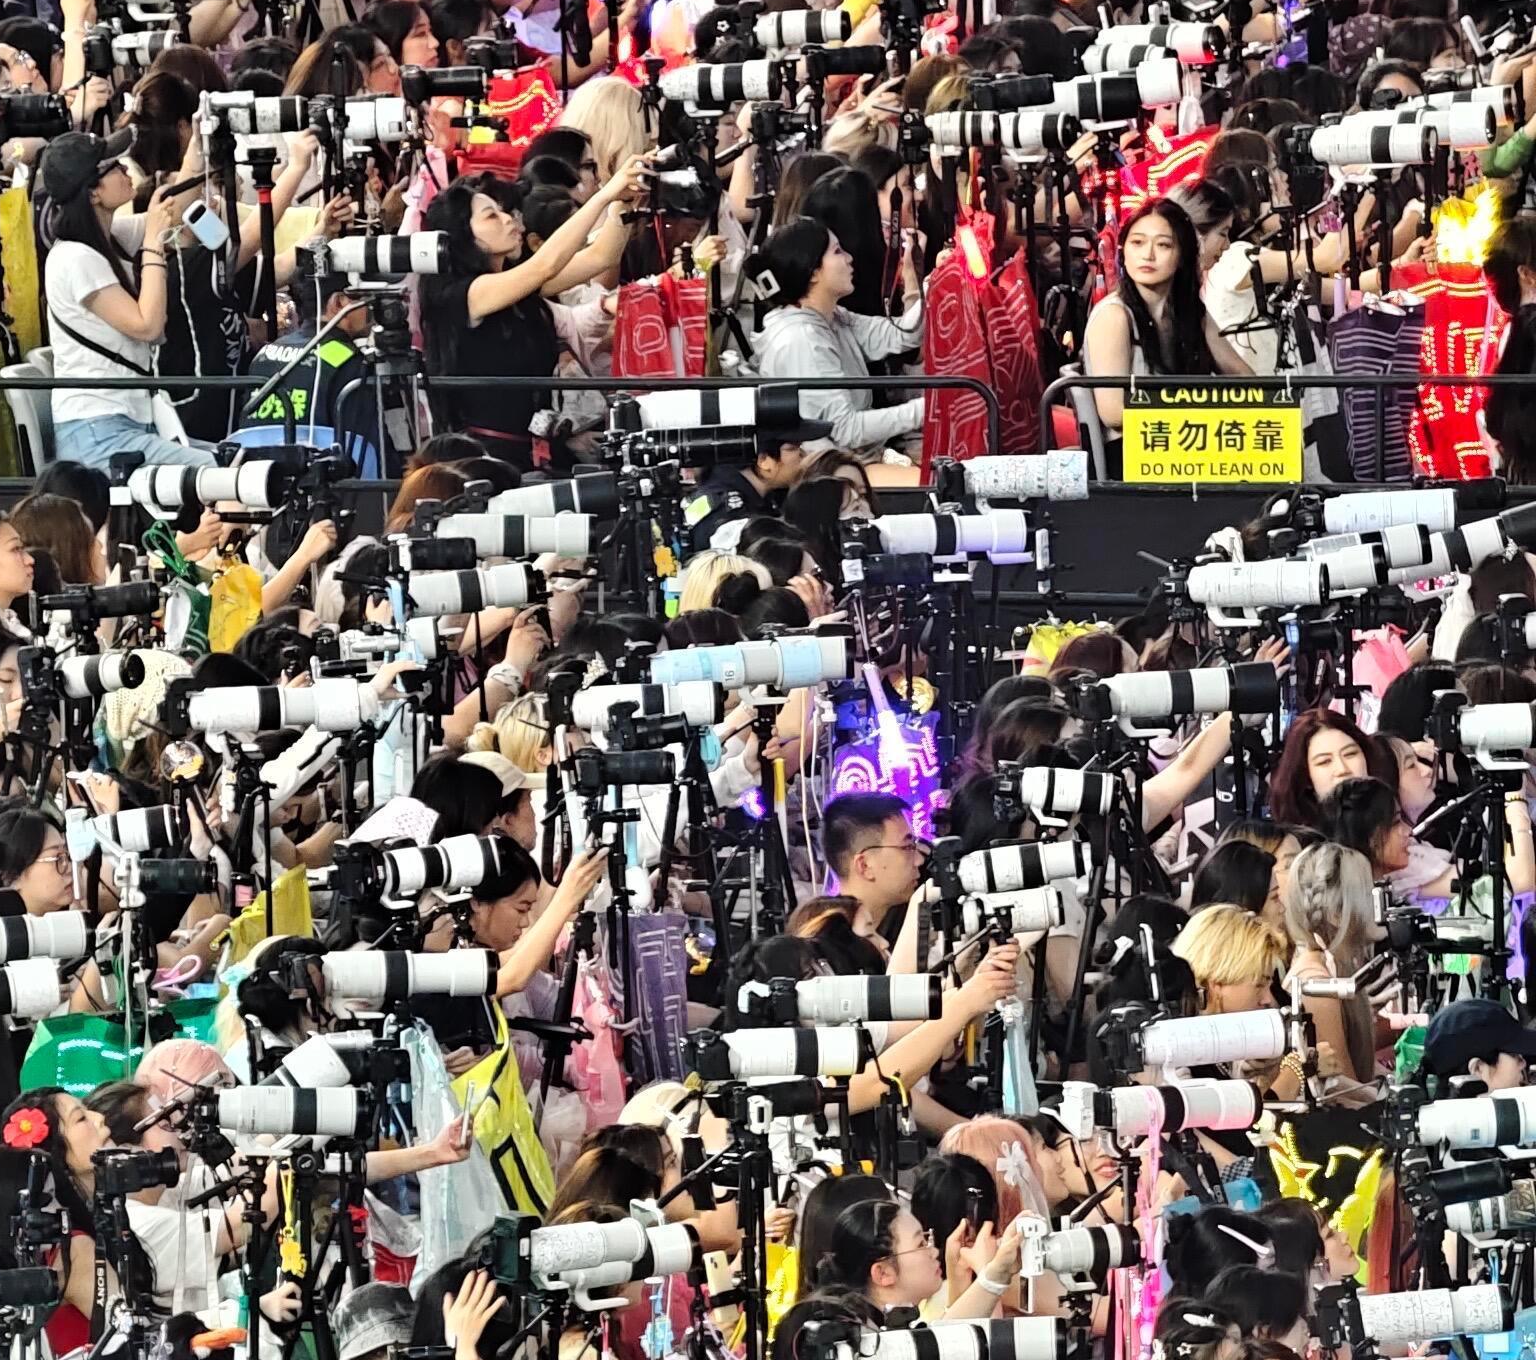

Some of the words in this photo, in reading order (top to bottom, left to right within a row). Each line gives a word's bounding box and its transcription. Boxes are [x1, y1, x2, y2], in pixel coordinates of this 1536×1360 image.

[1160, 388, 1264, 404] CAUTION
[1140, 419, 1285, 452] 请勿倚靠
[1140, 462, 1164, 476] DO
[1170, 462, 1206, 476] NOT
[1210, 462, 1253, 476] LEAN
[1259, 462, 1285, 476] ON
[96, 1267, 105, 1306] SONY
